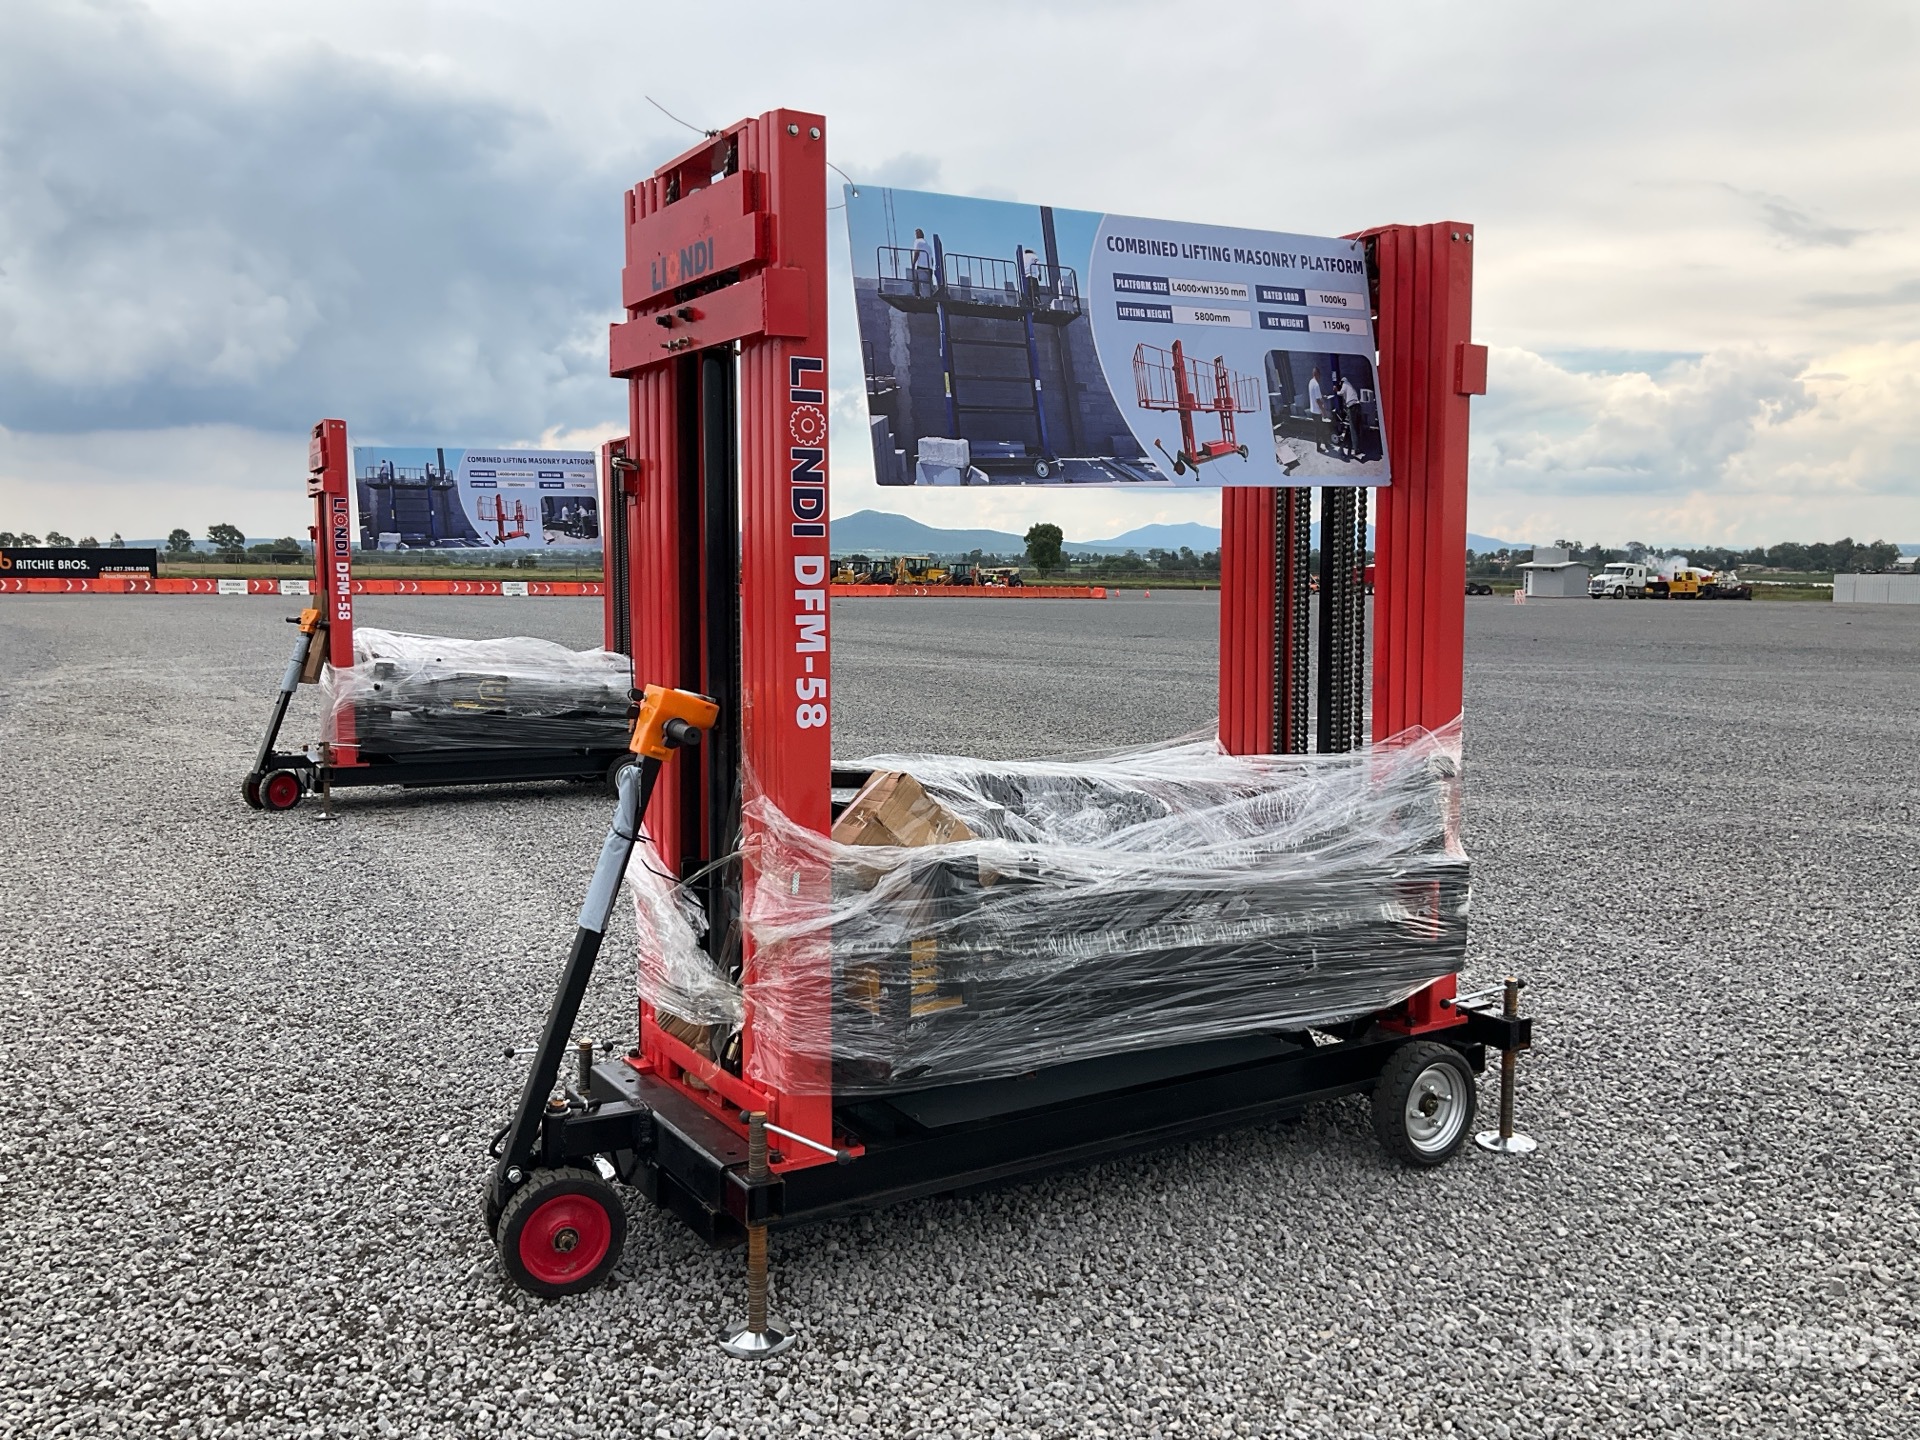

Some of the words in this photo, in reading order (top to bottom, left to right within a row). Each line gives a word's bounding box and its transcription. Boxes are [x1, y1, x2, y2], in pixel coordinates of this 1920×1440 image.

[1106, 235, 1178, 258] COMBINED
[1181, 243, 1231, 263] LIFTING
[1233, 248, 1297, 269] MASONRY
[1300, 254, 1364, 275] PLATFORM
[1115, 278, 1152, 291] PLATFORM
[1152, 282, 1168, 292] SIZE
[1230, 289, 1247, 297] mm
[1263, 290, 1282, 301] RATED
[1283, 292, 1300, 302] LOAD
[1319, 294, 1347, 307] 1000kg
[1118, 307, 1146, 318] LIFTING
[1146, 308, 1172, 320] HEIGHT
[1194, 311, 1231, 323] 5800mm
[1267, 317, 1279, 327] NET
[1279, 318, 1304, 329] WEIGHT
[1322, 320, 1350, 332] 1150kg
[789, 355, 826, 538] LIONDI
[467, 456, 502, 464] COMBINED
[528, 457, 561, 465] MASONRY
[561, 458, 595, 466] PLATFORM
[16, 559, 55, 570] RITCHIE
[58, 559, 90, 570] BROS.
[335, 562, 351, 621] DFM-58
[794, 555, 828, 729] DFM-58
